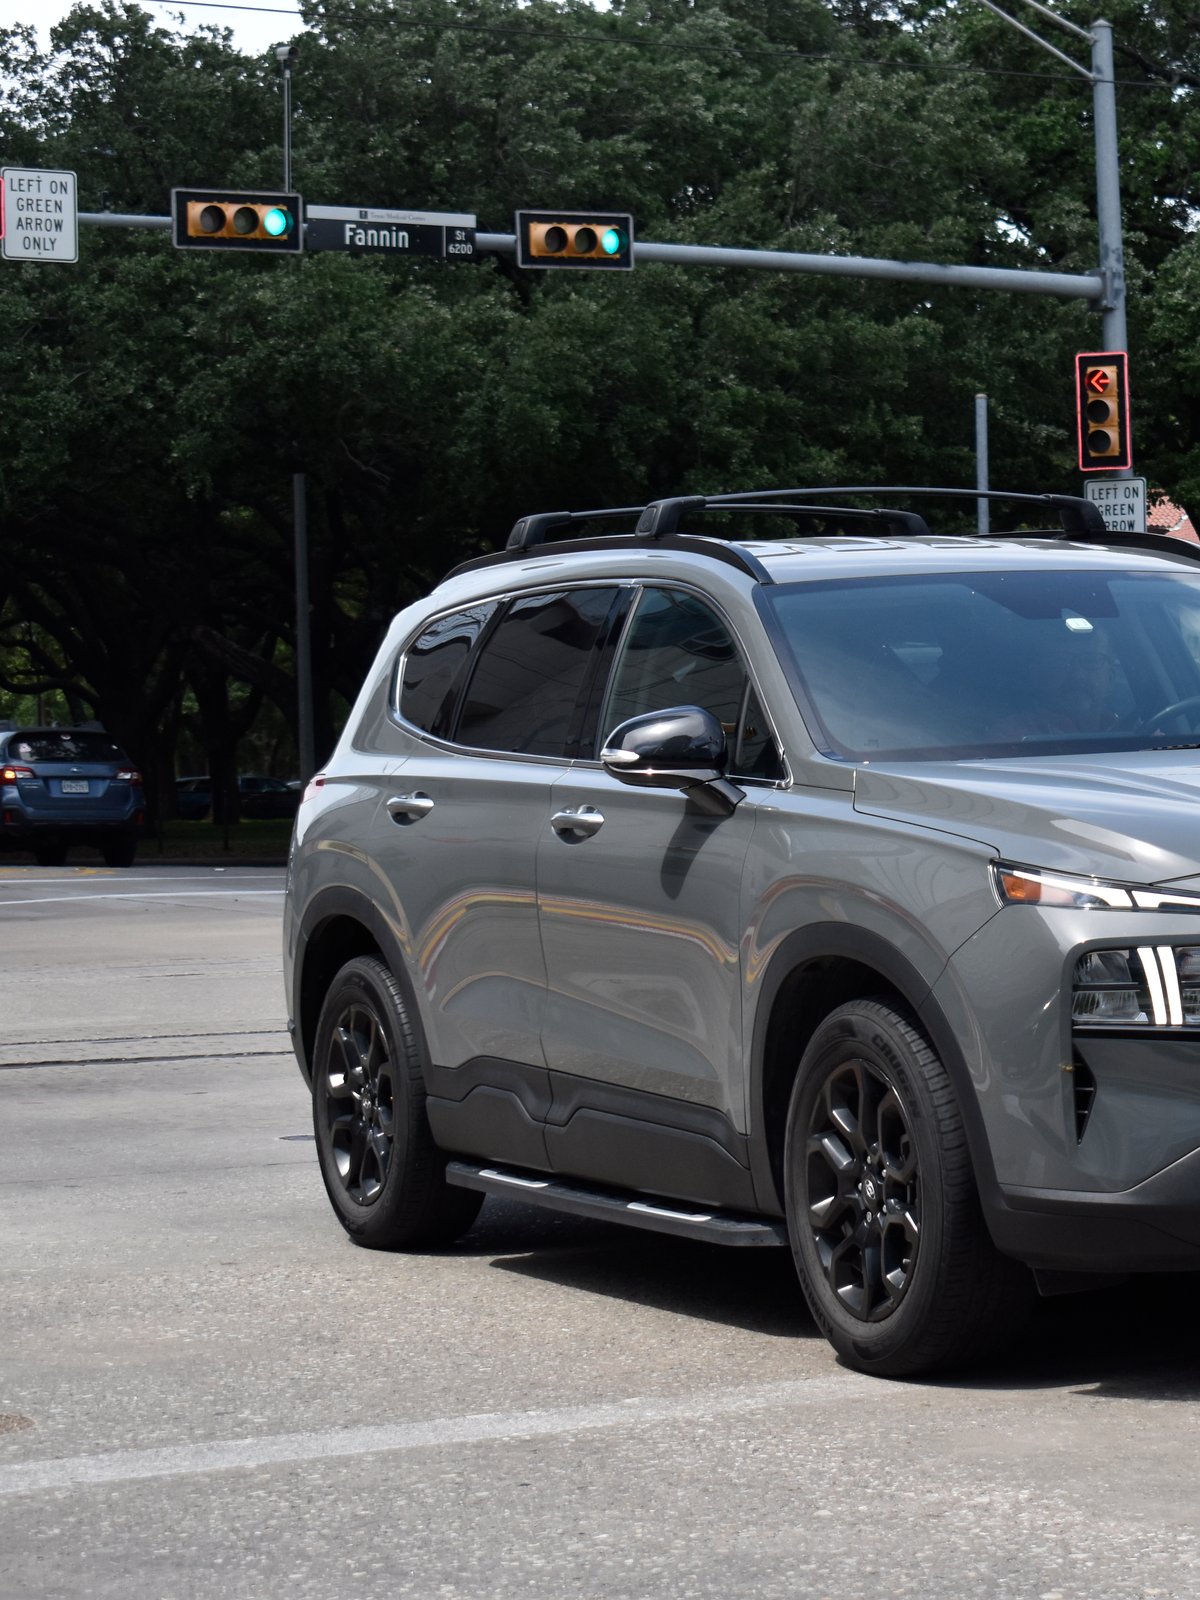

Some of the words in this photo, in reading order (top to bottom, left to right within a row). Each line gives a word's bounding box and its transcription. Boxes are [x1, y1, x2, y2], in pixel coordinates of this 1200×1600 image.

[10, 178, 42, 193] LEFT
[50, 180, 68, 194] ON
[16, 197, 63, 213] GREEN
[16, 217, 64, 232] ARROW
[344, 223, 410, 249] Fannin
[455, 230, 466, 241] St
[22, 236, 57, 251] ONLY
[449, 243, 473, 255] 6200
[1092, 488, 1118, 500] LEFT
[1124, 486, 1139, 499] ON
[1104, 519, 1136, 532] RROW
